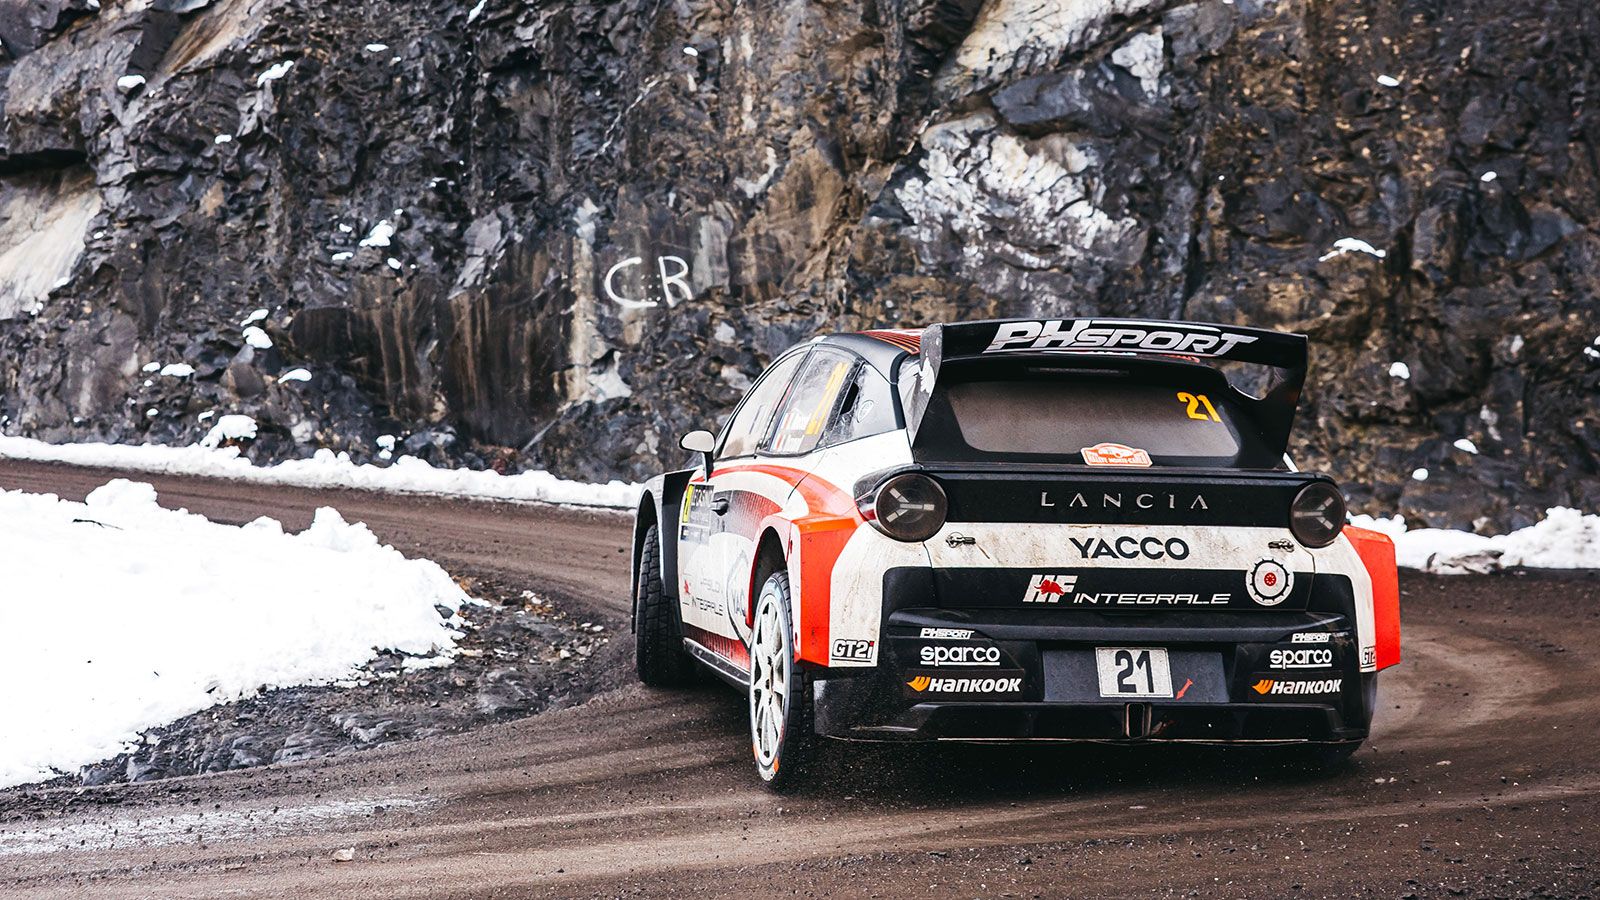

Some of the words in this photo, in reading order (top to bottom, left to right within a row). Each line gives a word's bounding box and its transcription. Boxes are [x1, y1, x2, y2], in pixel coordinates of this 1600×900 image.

[983, 320, 1259, 356] PHSPORT
[1177, 391, 1221, 423] 21
[1041, 492, 1208, 510] LANCIA
[1068, 536, 1190, 561] YACCO
[1074, 593, 1231, 605] INTEGRALE
[831, 639, 875, 660] GT2i
[920, 646, 1000, 666] sparco
[1270, 649, 1332, 669] sparco
[1115, 650, 1155, 693] 21
